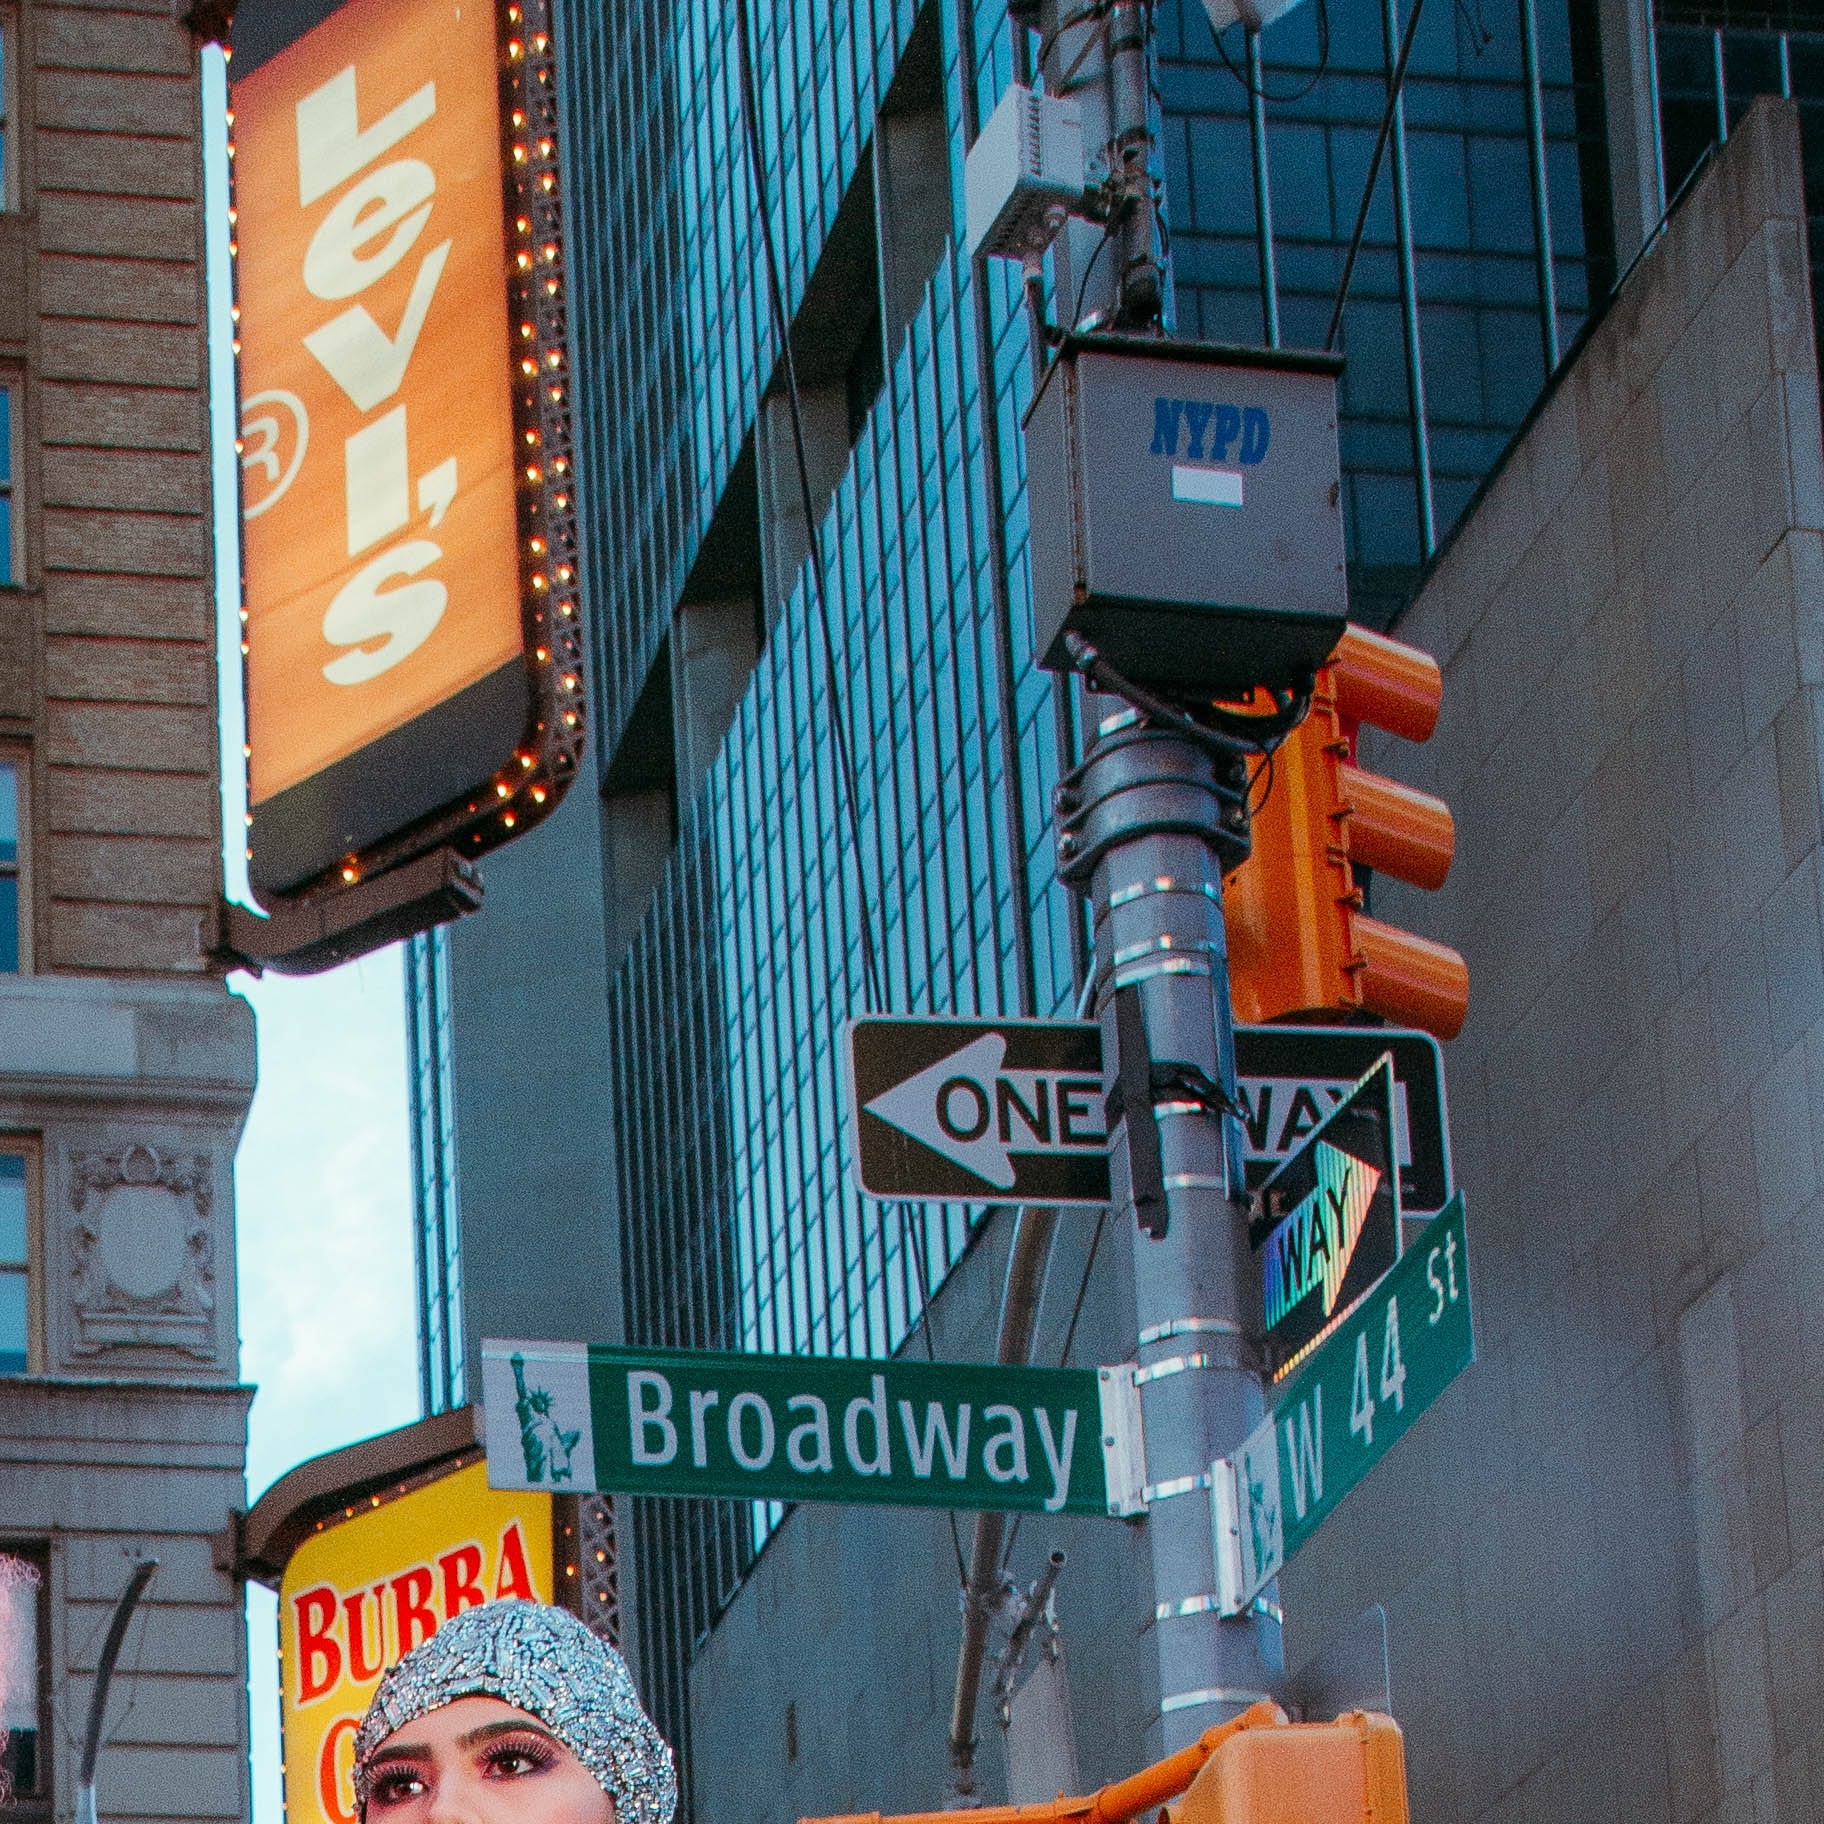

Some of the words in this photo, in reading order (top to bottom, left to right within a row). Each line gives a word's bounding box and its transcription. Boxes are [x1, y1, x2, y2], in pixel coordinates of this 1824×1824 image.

[1149, 396, 1271, 465] NYPD
[936, 1076, 1103, 1147] ONE
[1277, 1168, 1351, 1299] WAY
[626, 1370, 1078, 1512] Broadway
[1285, 1384, 1324, 1521] W
[1349, 1296, 1407, 1445] 44
[1426, 1231, 1458, 1325] St
[294, 1524, 536, 1705] BUBBA
